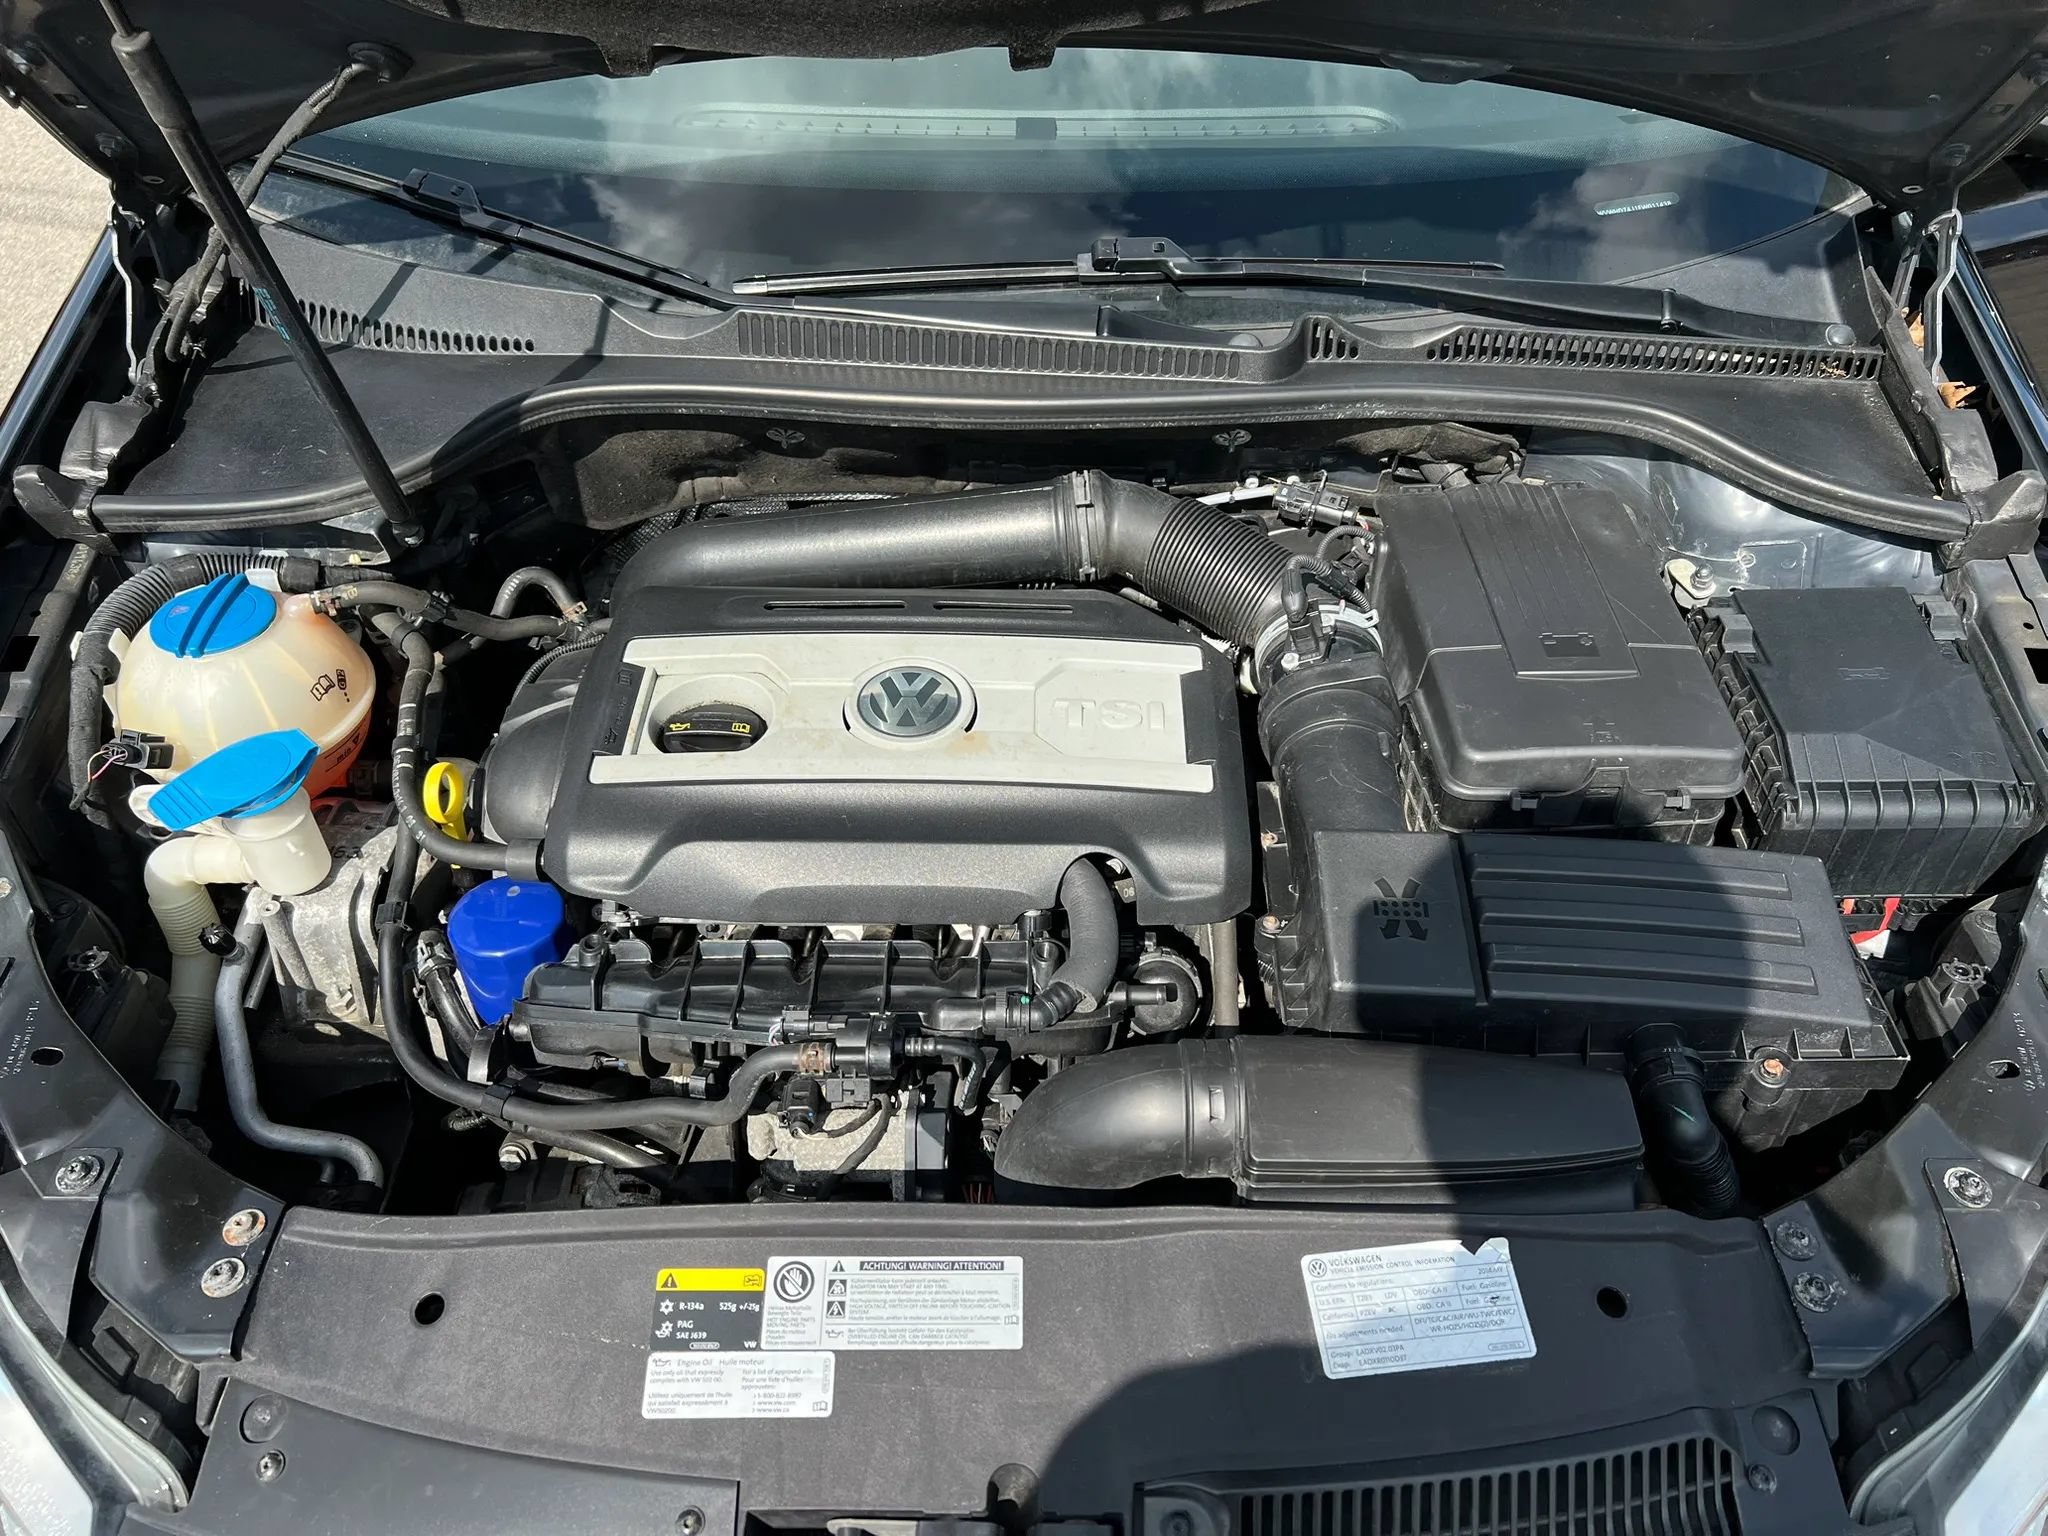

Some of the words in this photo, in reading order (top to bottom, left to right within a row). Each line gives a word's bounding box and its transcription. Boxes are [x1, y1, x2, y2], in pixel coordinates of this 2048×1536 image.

[1053, 698, 1165, 729] TSI
[1329, 1254, 1382, 1267] VOLKSWAGEN
[1386, 1261, 1413, 1269] CONTROL
[1414, 1256, 1456, 1265] INFORMATION
[863, 1261, 906, 1271] ACHTUNG!
[908, 1261, 952, 1270] WARNING!
[953, 1261, 1002, 1270] ATTENTION!
[1480, 1281, 1507, 1289] Gasoline
[680, 1302, 704, 1310] R-134a
[719, 1302, 737, 1312] 525g
[677, 1320, 694, 1329] PAG
[676, 1331, 689, 1339] SAE
[690, 1331, 707, 1339] J639
